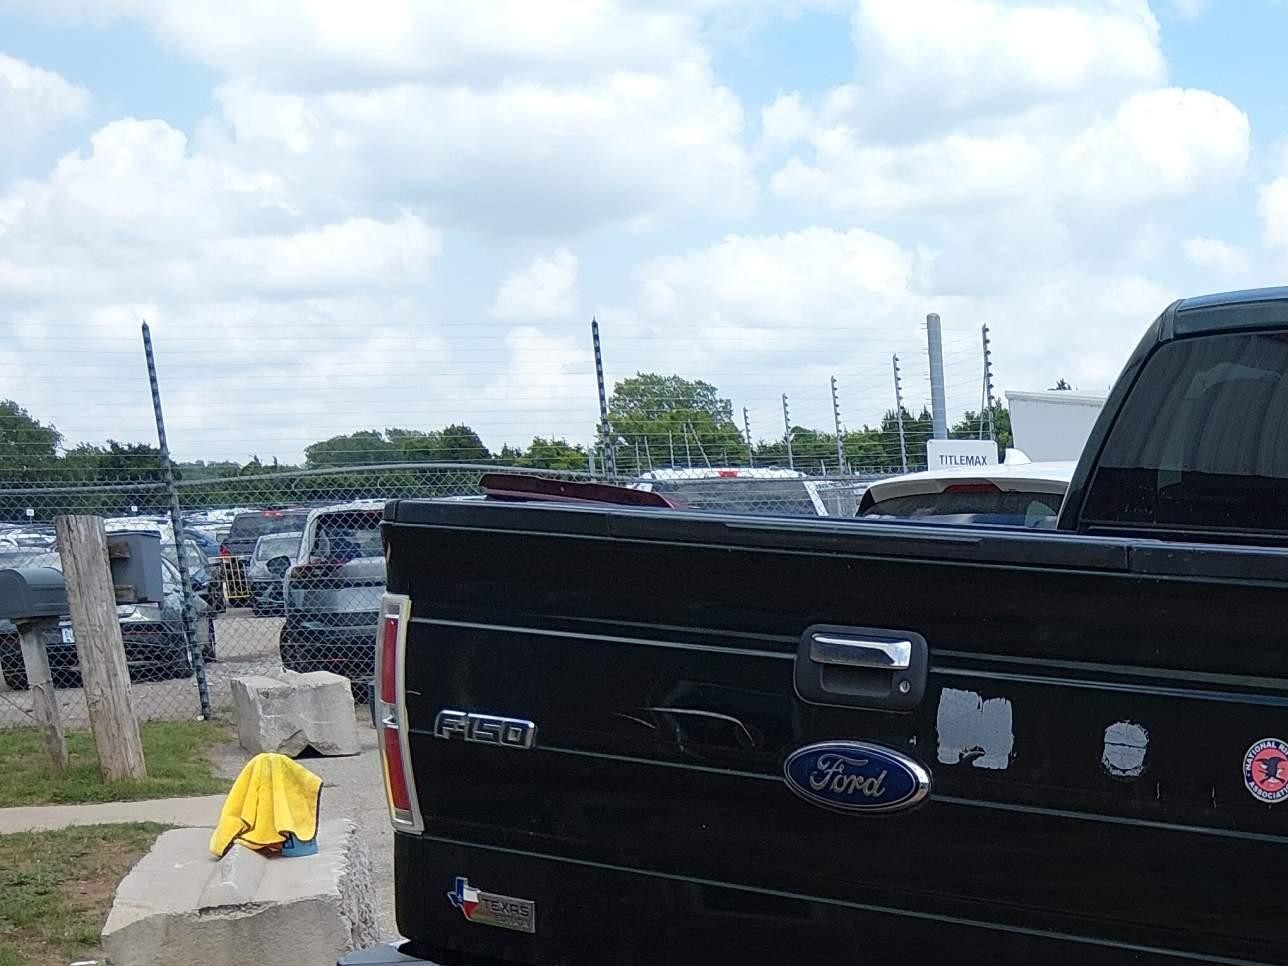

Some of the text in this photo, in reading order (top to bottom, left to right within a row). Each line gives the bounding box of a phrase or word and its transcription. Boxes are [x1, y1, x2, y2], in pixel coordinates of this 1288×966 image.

[939, 455, 988, 466] TITLEMAX
[1245, 741, 1278, 771] NATIONAL
[809, 752, 888, 798] Ford
[482, 899, 530, 917] TEXAS
